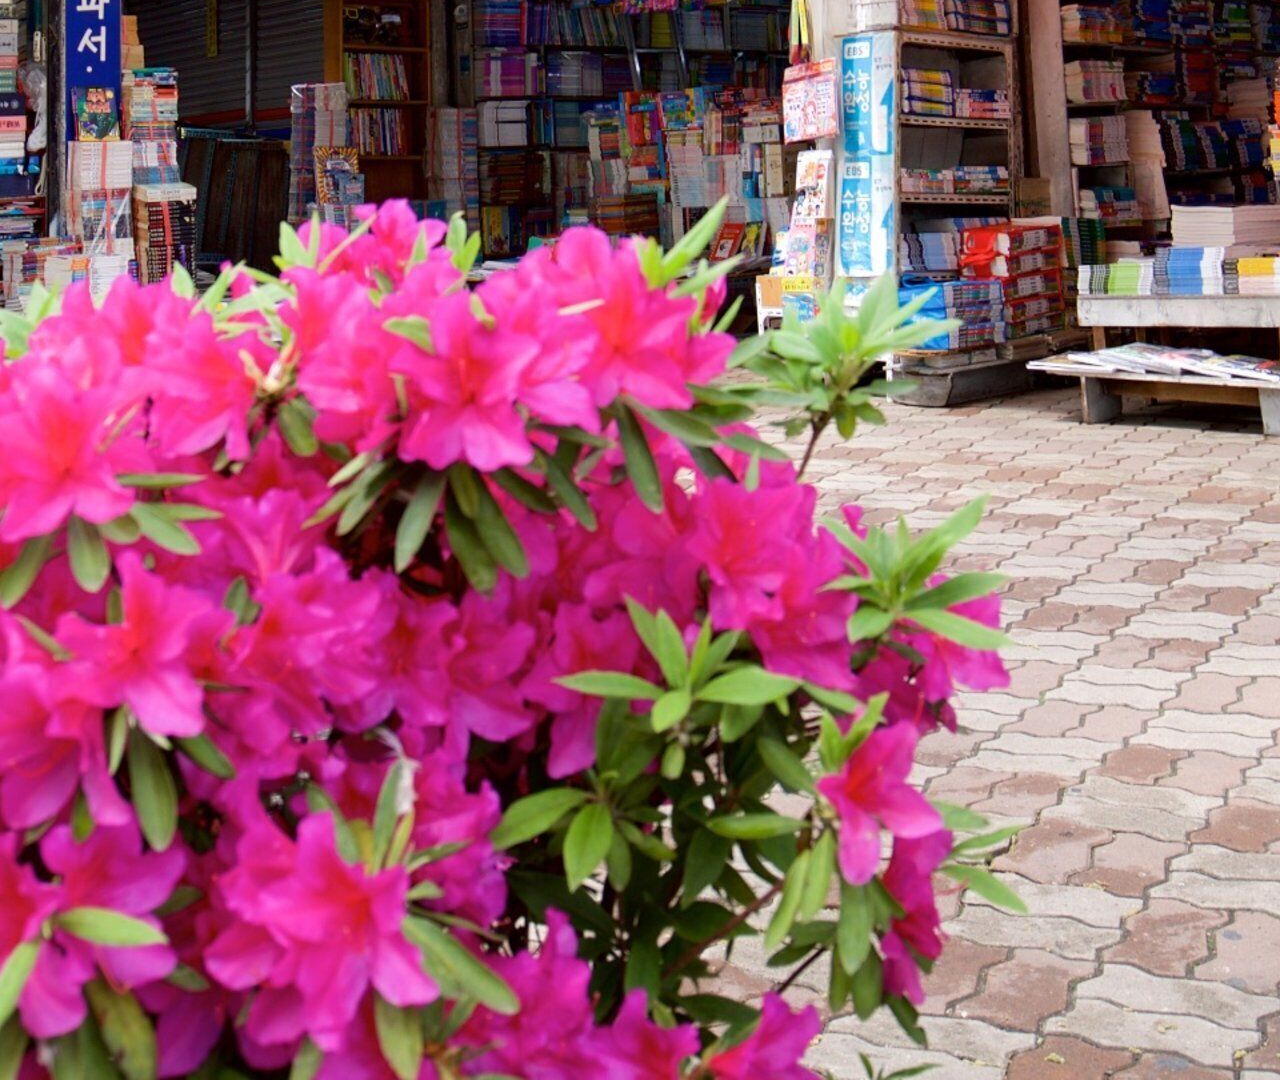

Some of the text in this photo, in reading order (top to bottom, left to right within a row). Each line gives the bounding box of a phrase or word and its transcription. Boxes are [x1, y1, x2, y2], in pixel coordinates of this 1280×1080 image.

[846, 46, 864, 57] EBS
[843, 69, 871, 88] 수능
[843, 94, 871, 114] 완성
[842, 190, 871, 209] 수능
